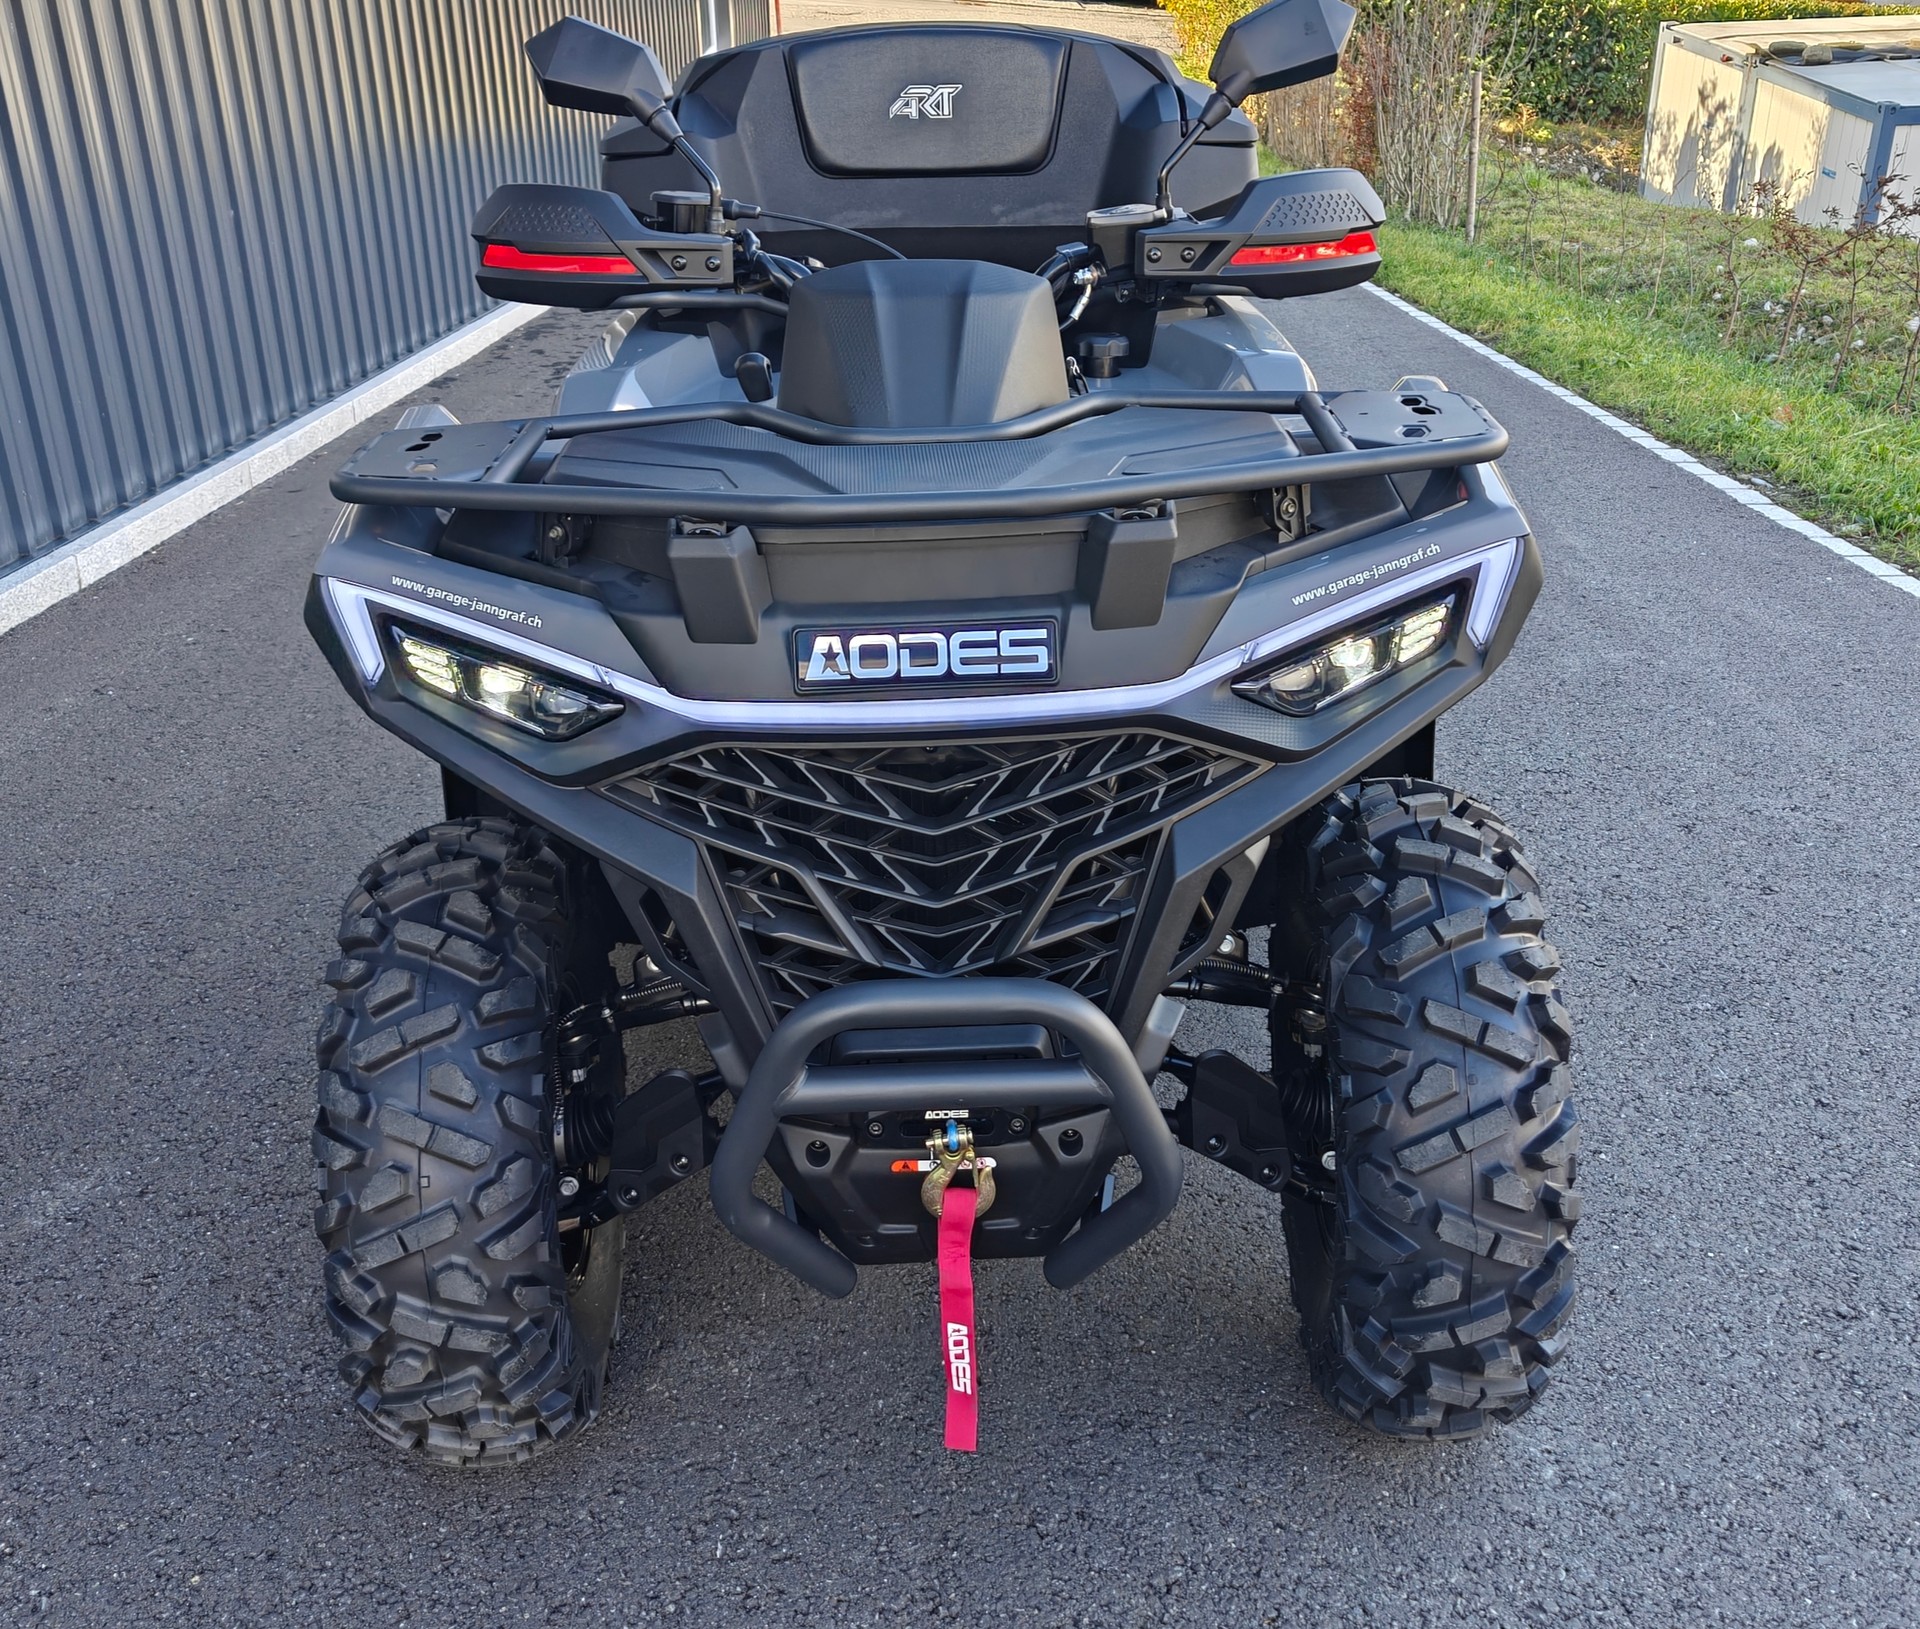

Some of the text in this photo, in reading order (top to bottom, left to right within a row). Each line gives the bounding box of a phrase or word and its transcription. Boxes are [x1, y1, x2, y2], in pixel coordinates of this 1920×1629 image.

[1292, 543, 1441, 606] www.garage-janngraf.ch
[391, 575, 543, 629] www.garage-janngraf.ch
[804, 628, 1049, 682] AODES
[924, 1109, 969, 1120] AODES
[946, 1322, 972, 1395] AODES
